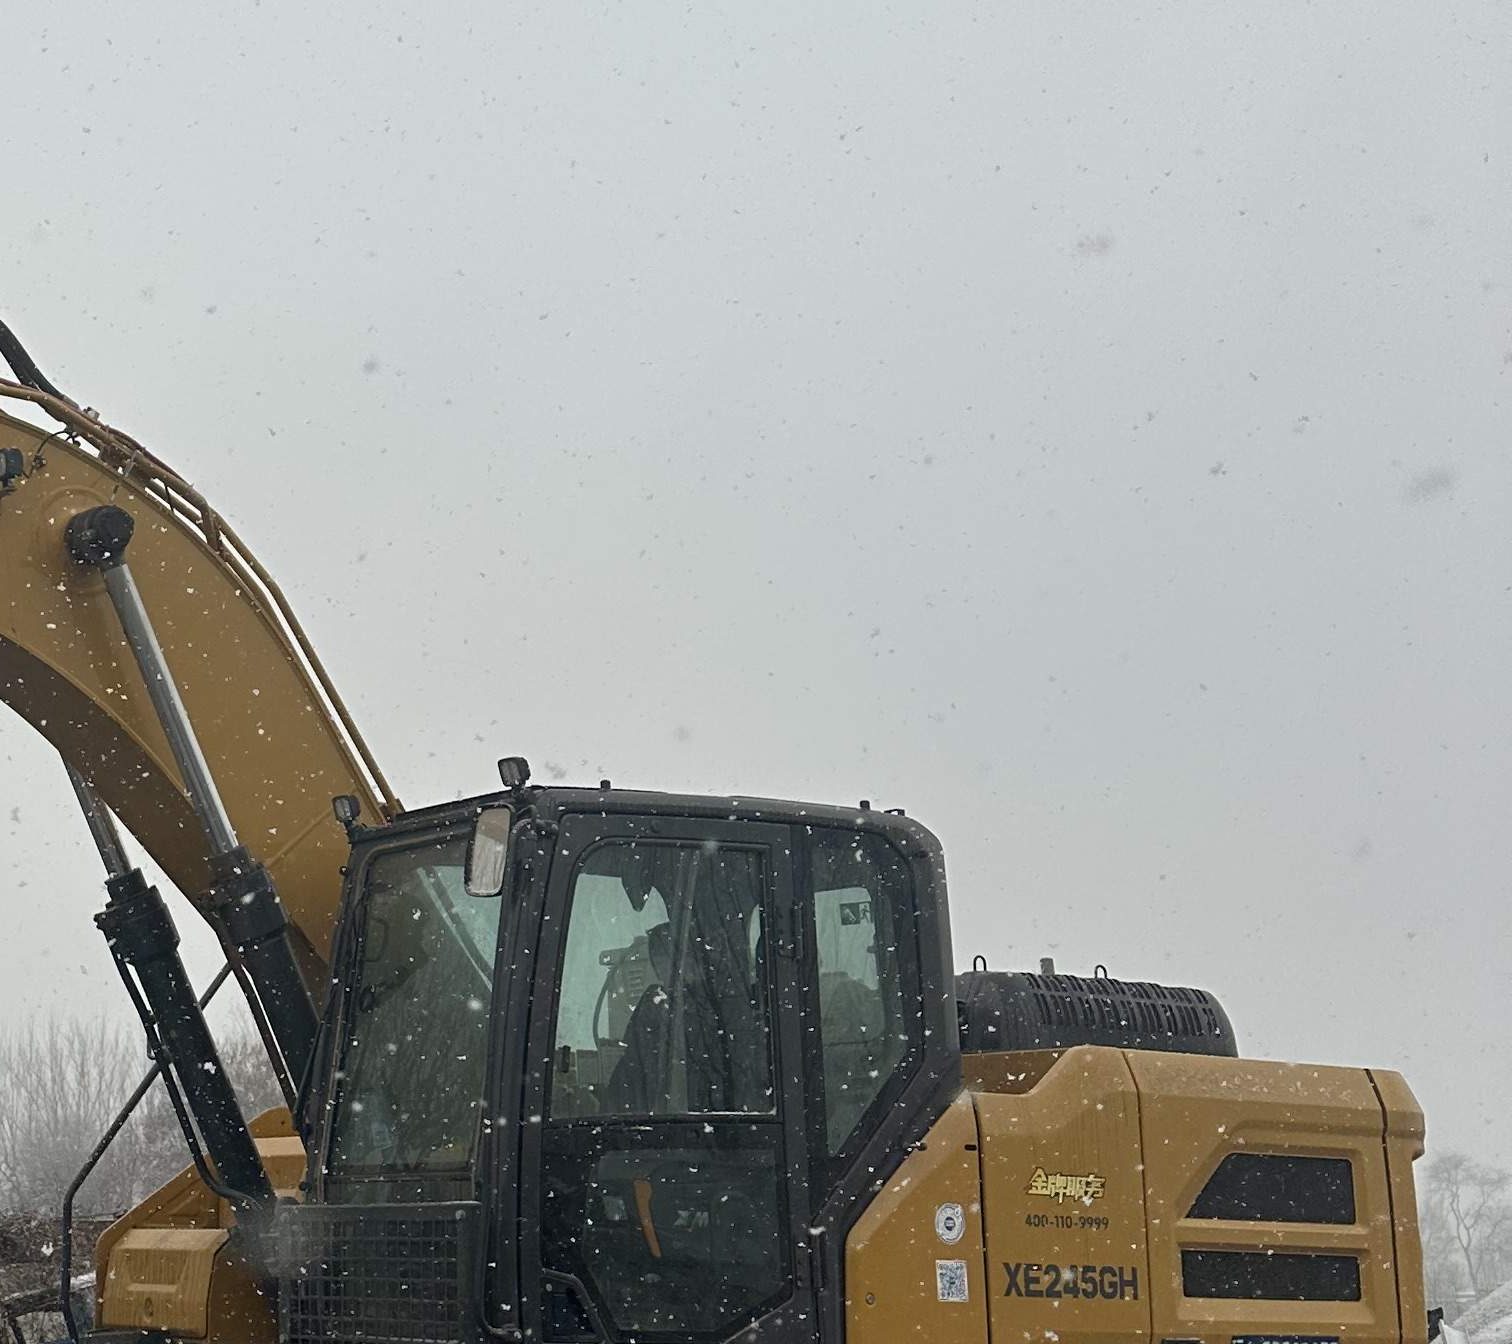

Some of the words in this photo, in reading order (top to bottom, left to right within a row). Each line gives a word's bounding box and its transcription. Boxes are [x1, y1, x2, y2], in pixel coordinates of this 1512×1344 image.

[1027, 1166, 1106, 1203] 金牌服务
[1025, 1213, 1110, 1231] 400-110-9999
[1002, 1262, 1139, 1301] XE245GH
